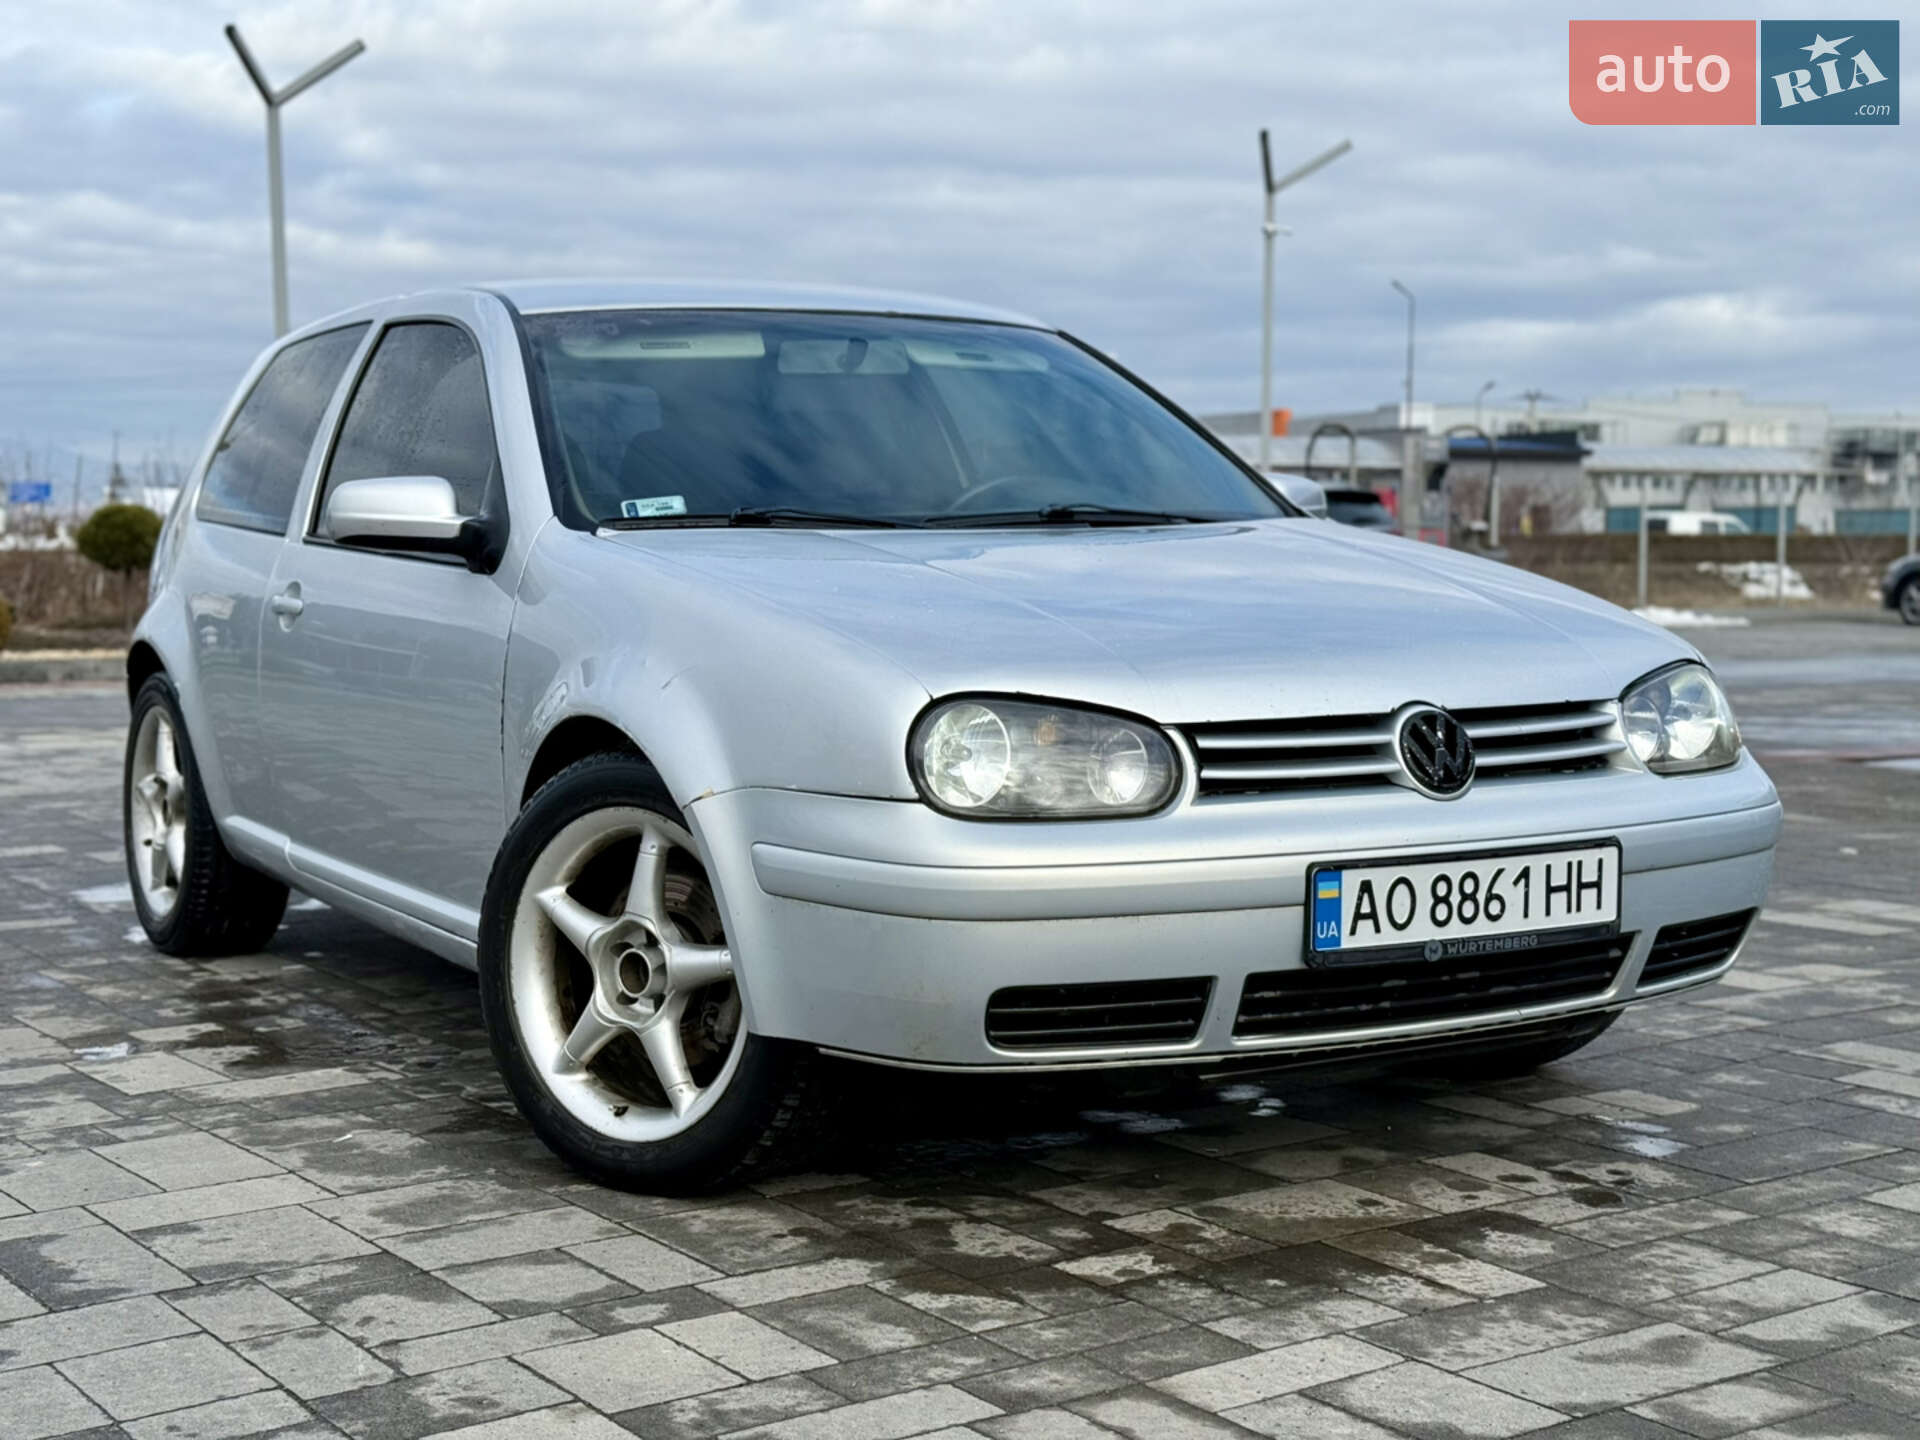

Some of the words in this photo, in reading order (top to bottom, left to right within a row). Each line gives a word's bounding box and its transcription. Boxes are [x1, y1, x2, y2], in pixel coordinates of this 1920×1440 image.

[1400, 710, 1471, 790] VW
[1316, 921, 1339, 939] UA
[1349, 876, 1417, 936] AO
[1430, 865, 1532, 928] 8861
[1545, 857, 1603, 917] HH
